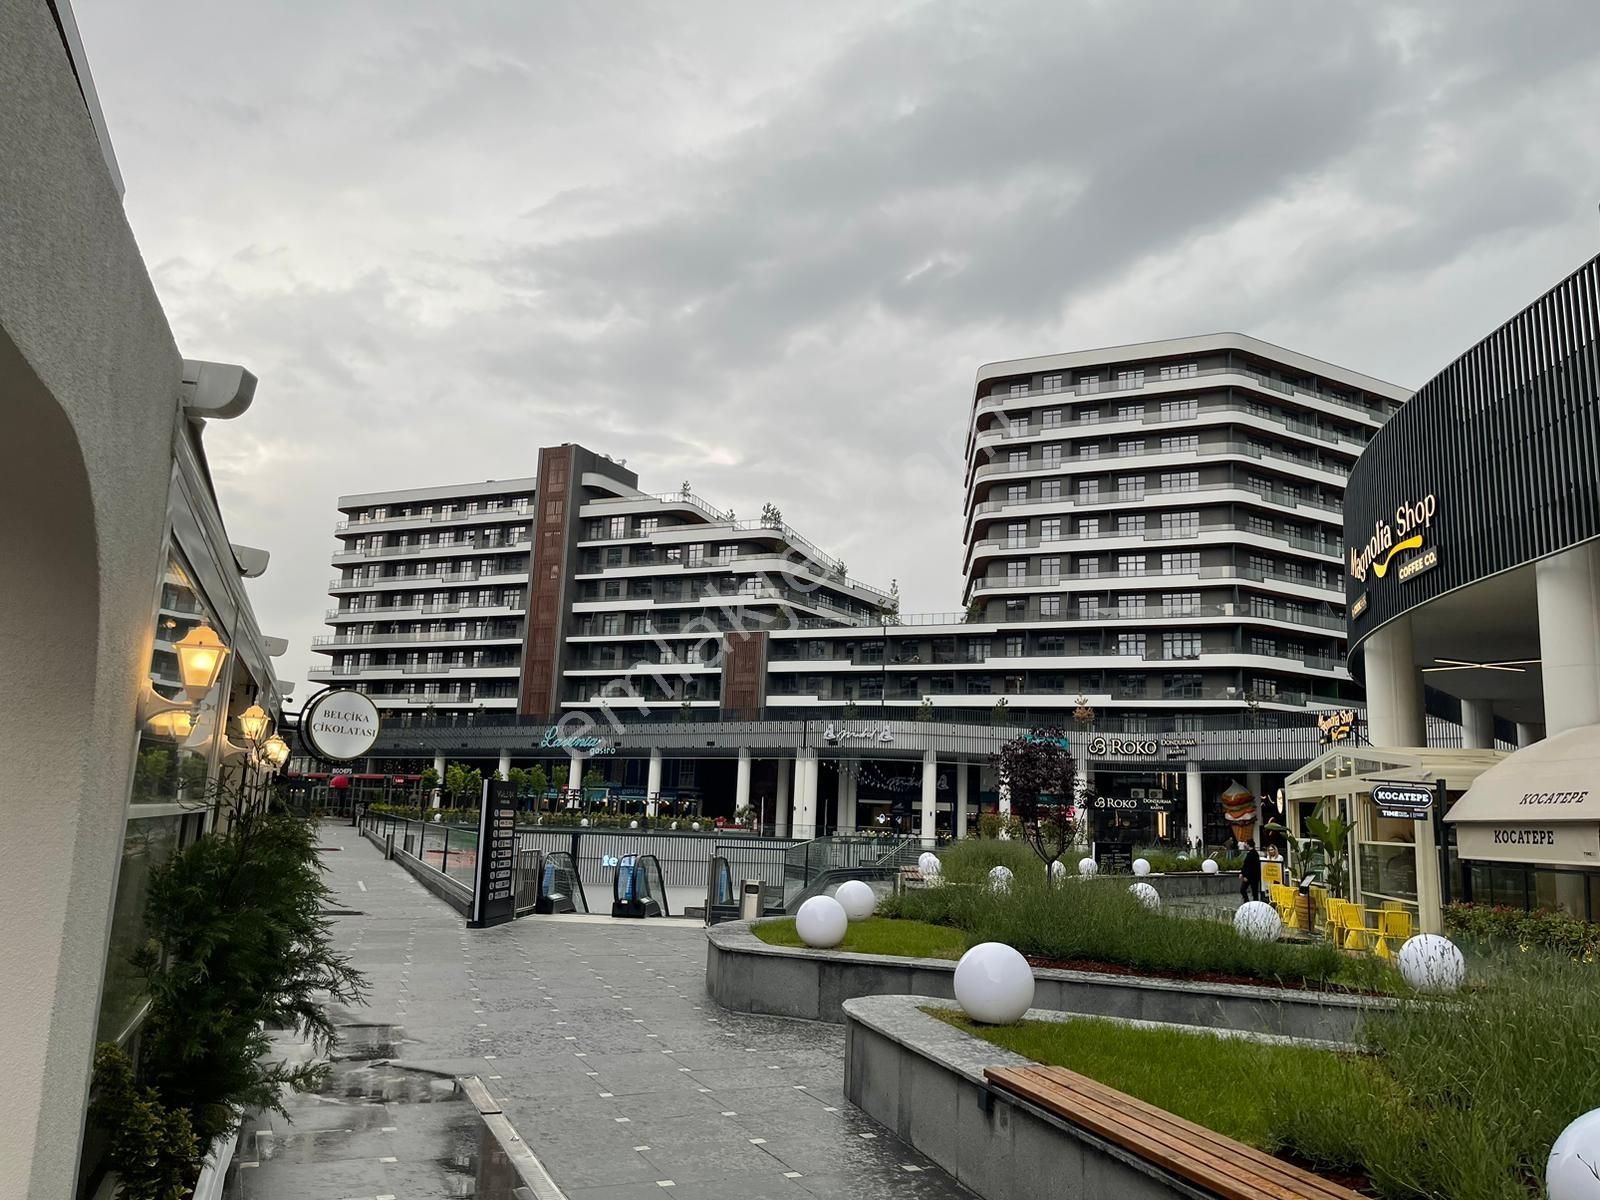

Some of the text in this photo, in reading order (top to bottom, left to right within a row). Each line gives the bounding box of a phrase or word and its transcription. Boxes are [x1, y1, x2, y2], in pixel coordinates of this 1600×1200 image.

[1350, 493, 1436, 582] Magnolia Shop
[1399, 551, 1437, 580] COFFEE CO.
[323, 709, 370, 723] BELÇİKA
[313, 721, 376, 738] ÇİKOLATASI
[1110, 738, 1157, 755] ROKO
[1106, 797, 1137, 809] ROKO
[1377, 790, 1430, 803] KOCATEPE
[1520, 791, 1589, 805] KOCATEPE
[1494, 829, 1554, 845] KOCATEPE
